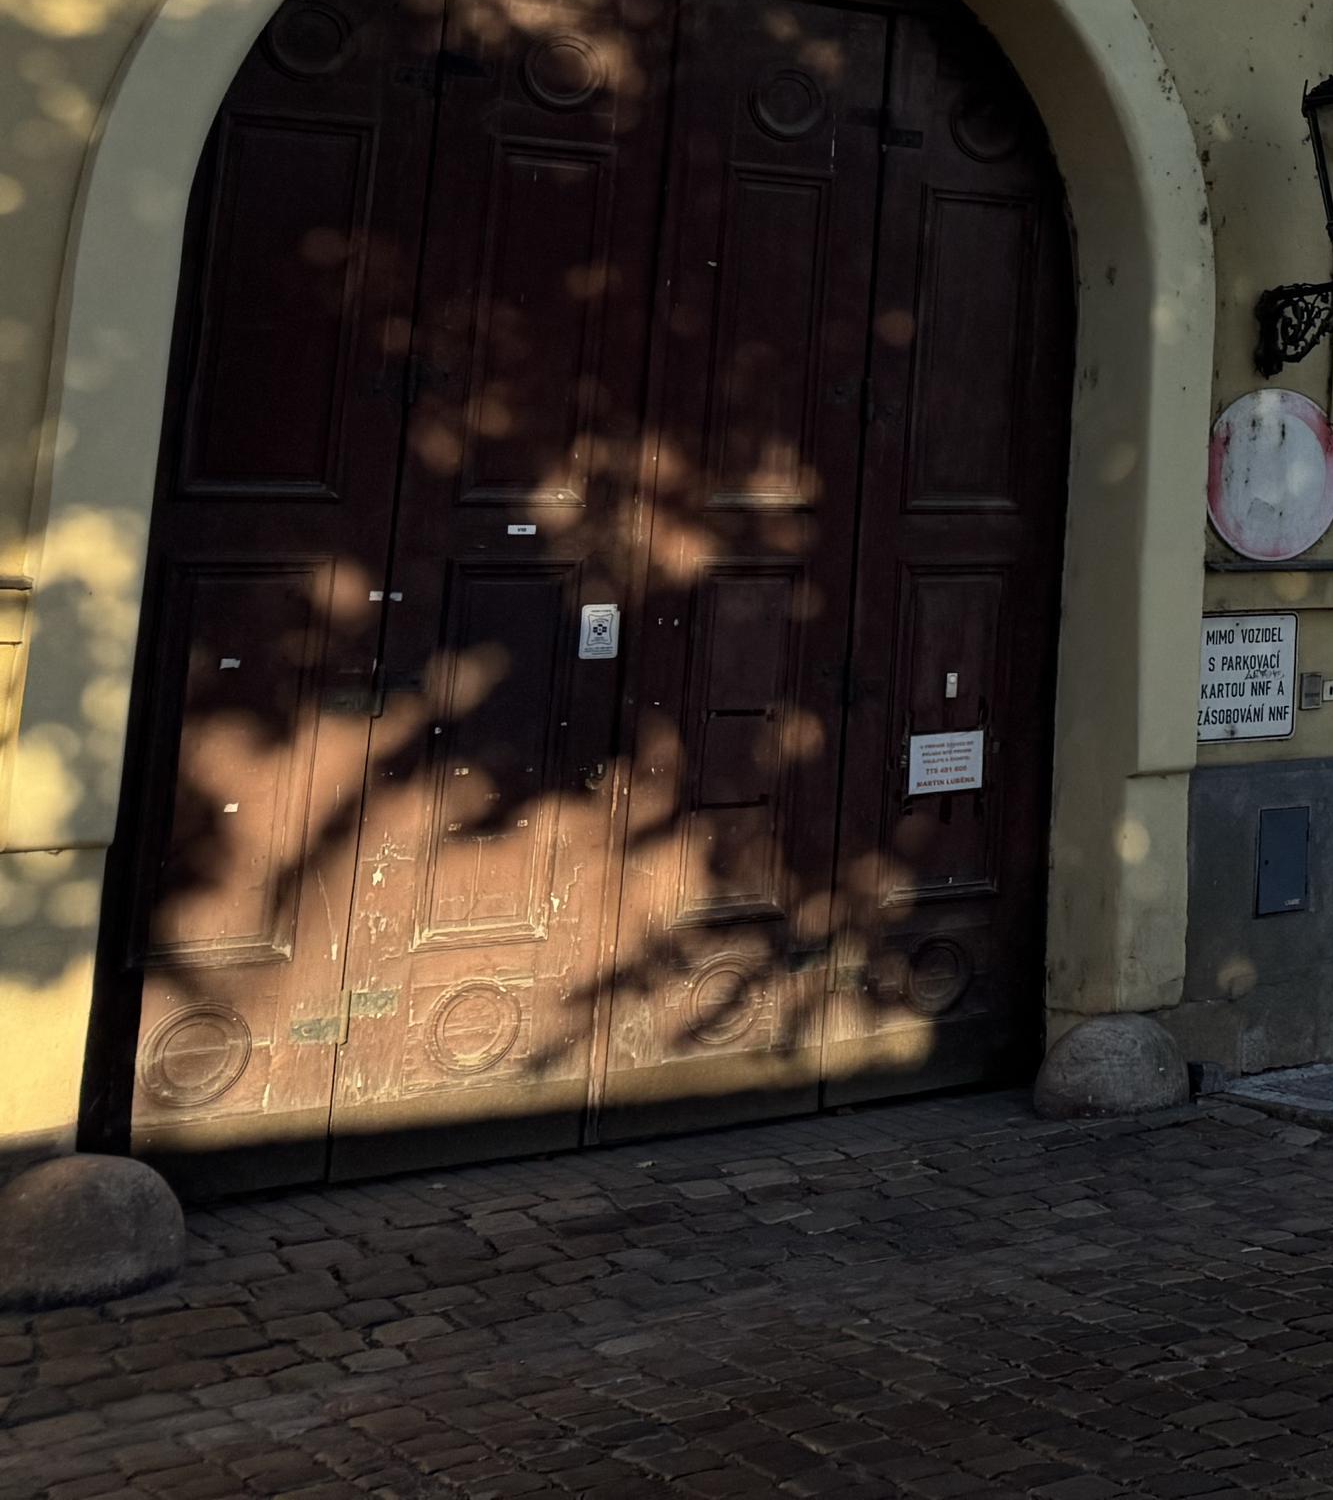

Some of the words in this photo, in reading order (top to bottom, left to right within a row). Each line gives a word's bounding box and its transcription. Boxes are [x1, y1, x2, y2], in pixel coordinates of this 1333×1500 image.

[1206, 629, 1235, 646] MIMO
[1241, 627, 1284, 644] VOZIDEL
[1208, 656, 1216, 672] S
[1221, 650, 1280, 671] PARKOVACÍ
[1200, 682, 1245, 700] KARTOU
[1250, 680, 1272, 697] NNF
[1277, 680, 1285, 696] A
[1197, 703, 1264, 726] ZÁSOBOVÁNÍ
[1268, 705, 1290, 722] NNF
